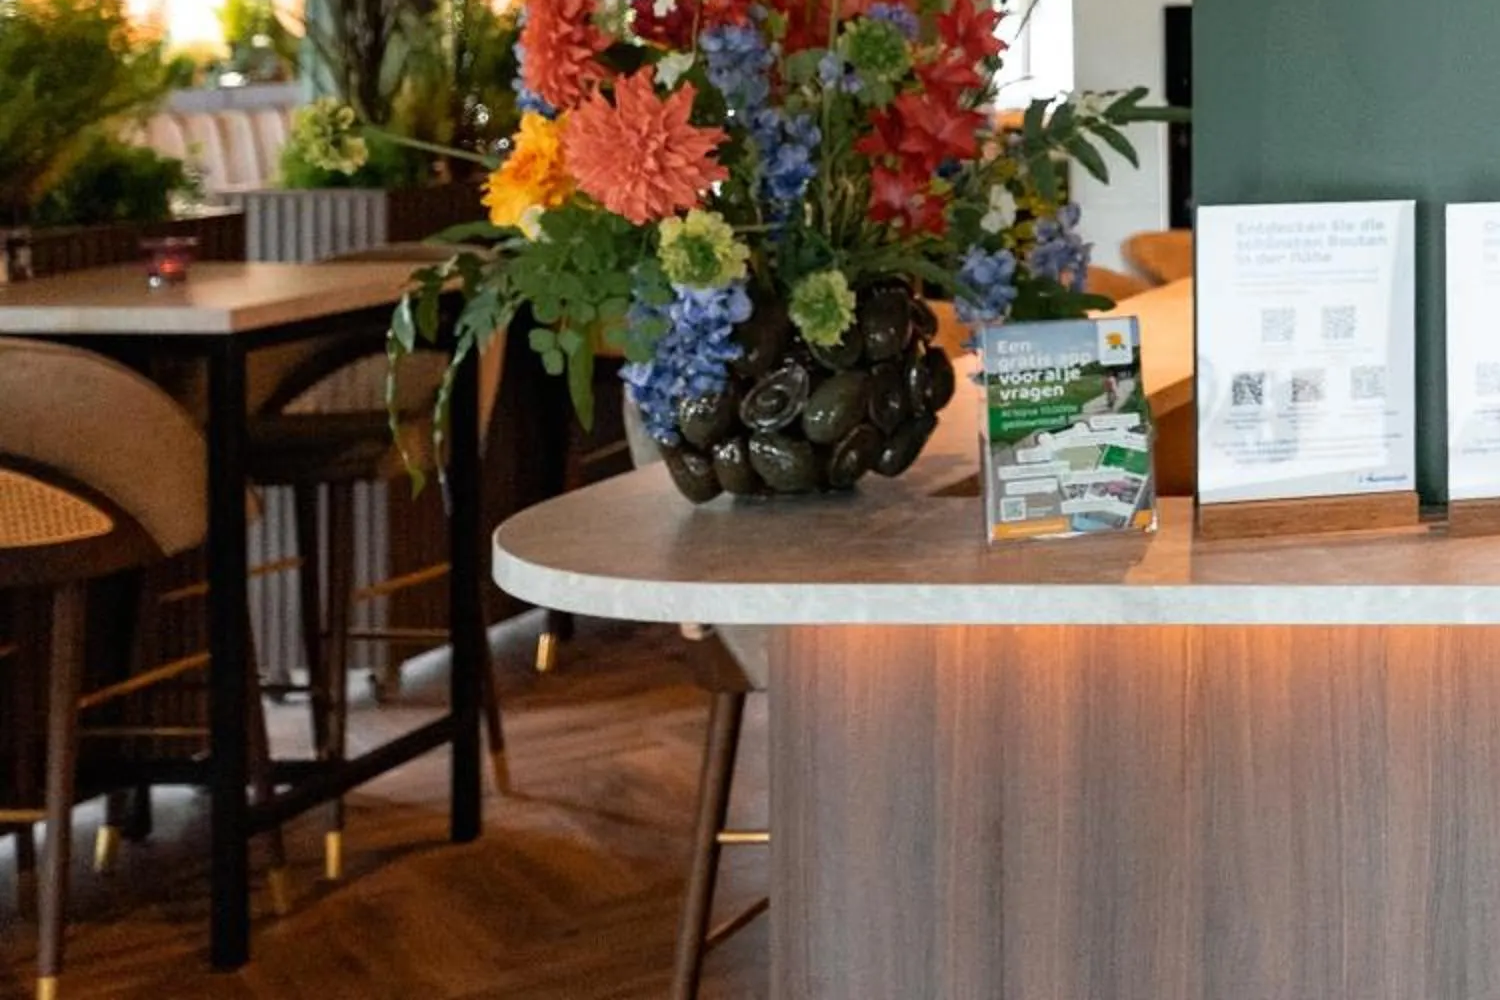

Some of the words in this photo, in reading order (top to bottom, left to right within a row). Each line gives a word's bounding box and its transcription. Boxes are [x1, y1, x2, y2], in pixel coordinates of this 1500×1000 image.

[997, 341, 1031, 355] Een
[1000, 371, 1043, 386] voor
[1001, 385, 1064, 403] vragen
